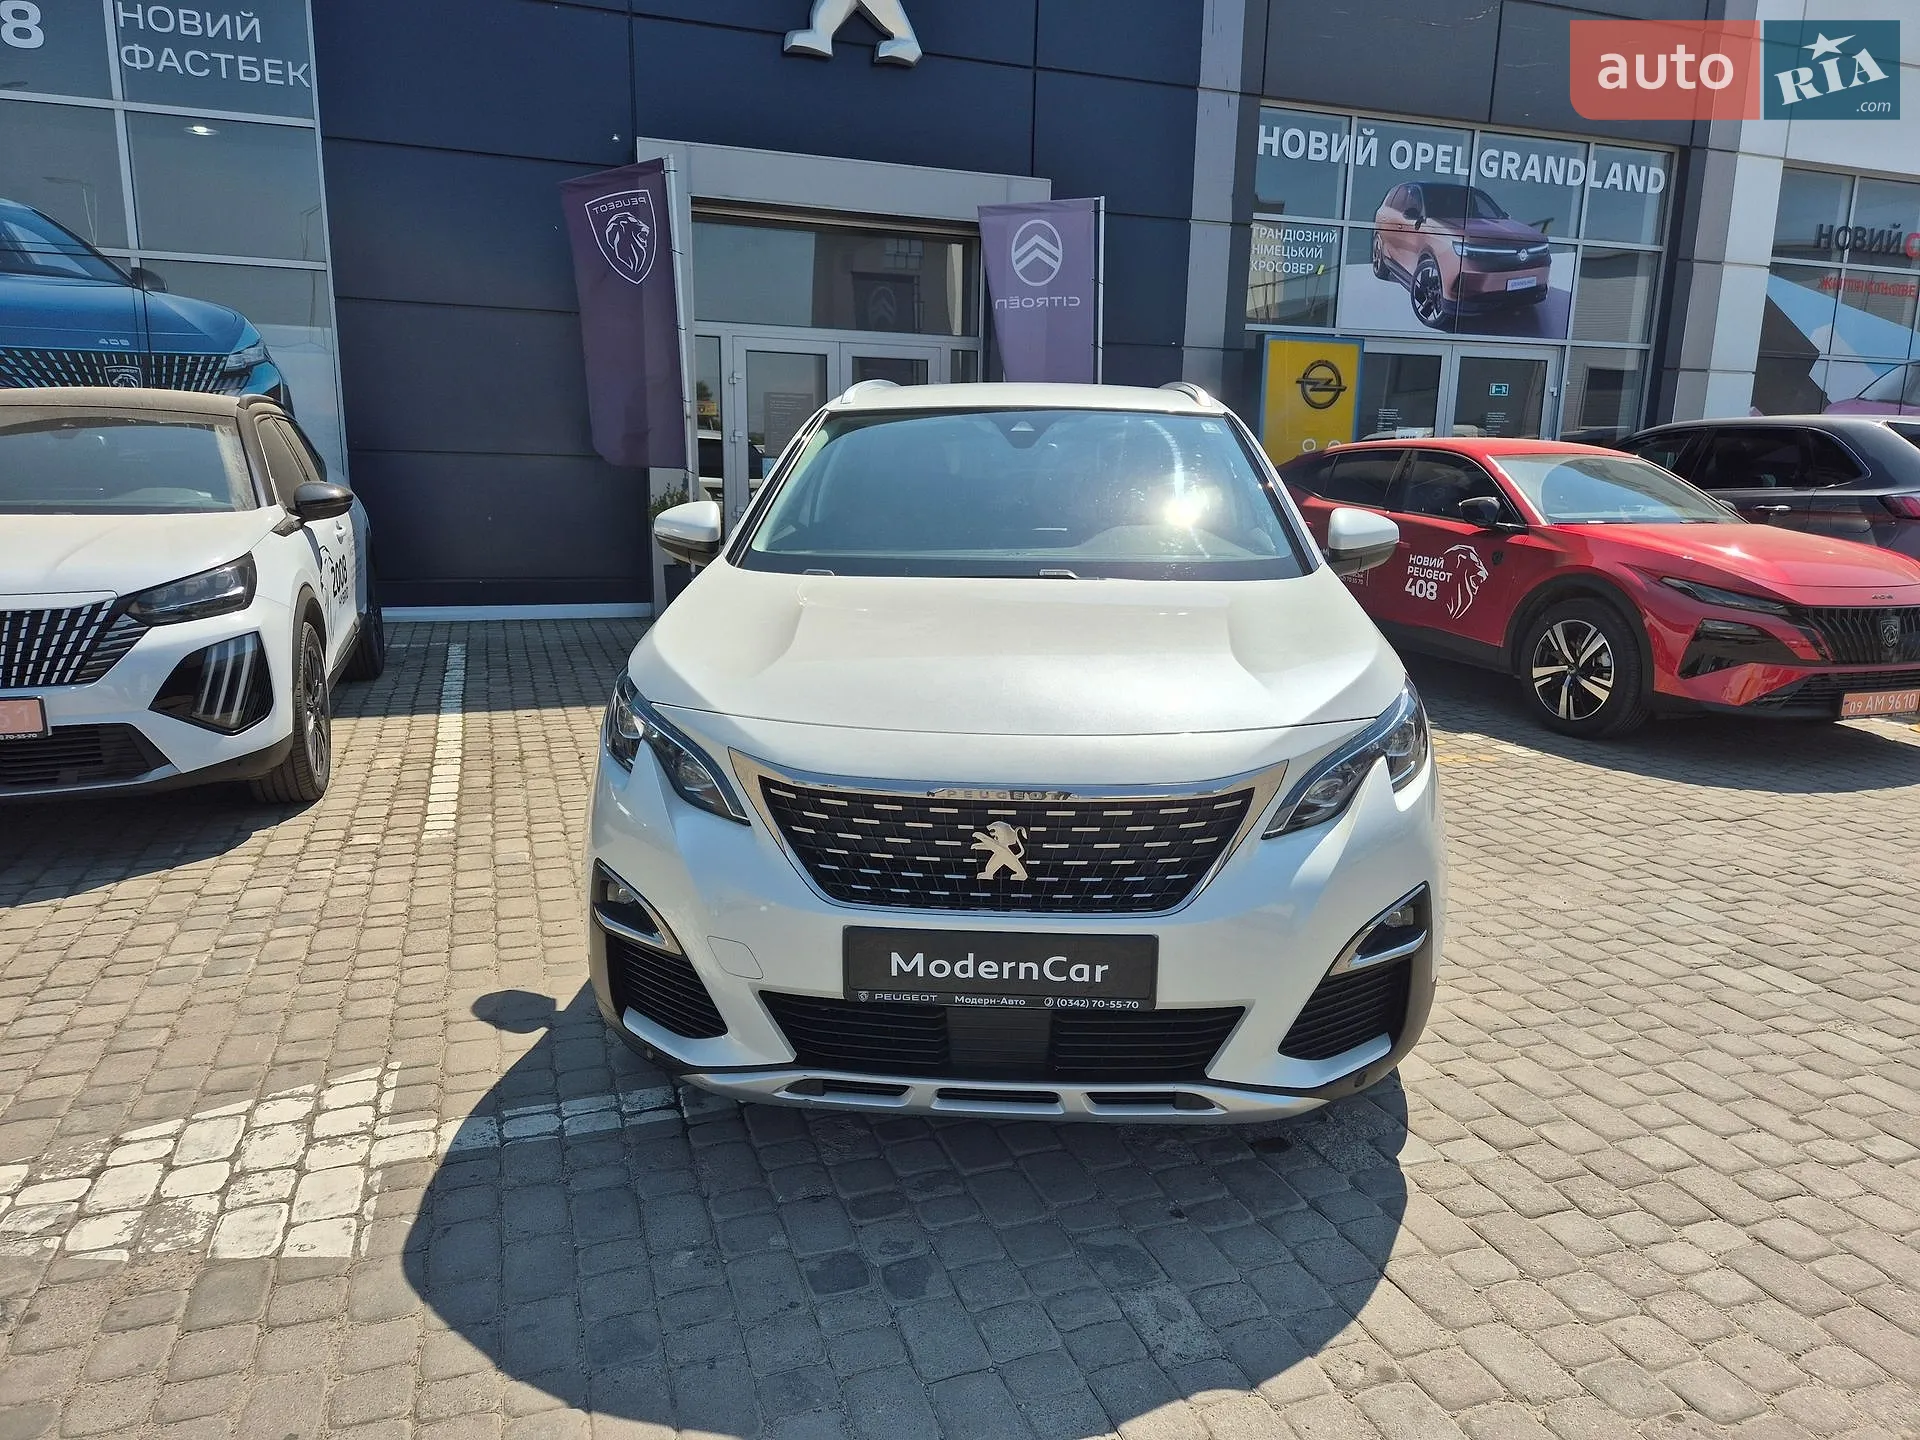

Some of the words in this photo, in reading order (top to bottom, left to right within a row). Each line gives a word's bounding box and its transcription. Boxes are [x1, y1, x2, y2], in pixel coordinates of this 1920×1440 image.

[0, 0, 44, 49] 8
[117, 1, 262, 44] НОВИЙ
[120, 43, 311, 88] ФАСТБЕК
[1257, 124, 1379, 167] НОВИЙ
[1389, 139, 1470, 176] OPEL
[1478, 148, 1667, 195] GRANDLAND
[1250, 226, 1338, 244] ГРАНДІОЗНИЙ
[1815, 223, 1903, 253] НОВИЙ
[1250, 244, 1323, 259] НІМЕЦЬКИЙ
[1250, 259, 1314, 274] КРОСОВЕР
[1409, 554, 1445, 569] НОВИЙ
[1407, 565, 1453, 583] PEUGEOT
[1404, 577, 1438, 600] 408
[1849, 701, 1863, 714] 09
[1865, 695, 1885, 712] AM
[947, 790, 1060, 801] PEUGEOT
[890, 951, 1109, 983] ModernCar
[874, 993, 938, 1002] PEUGEOT
[954, 995, 1026, 1006] Модерн-Авто
[1056, 998, 1089, 1009] (0342)
[1091, 1000, 1139, 1010] 70-55-70
